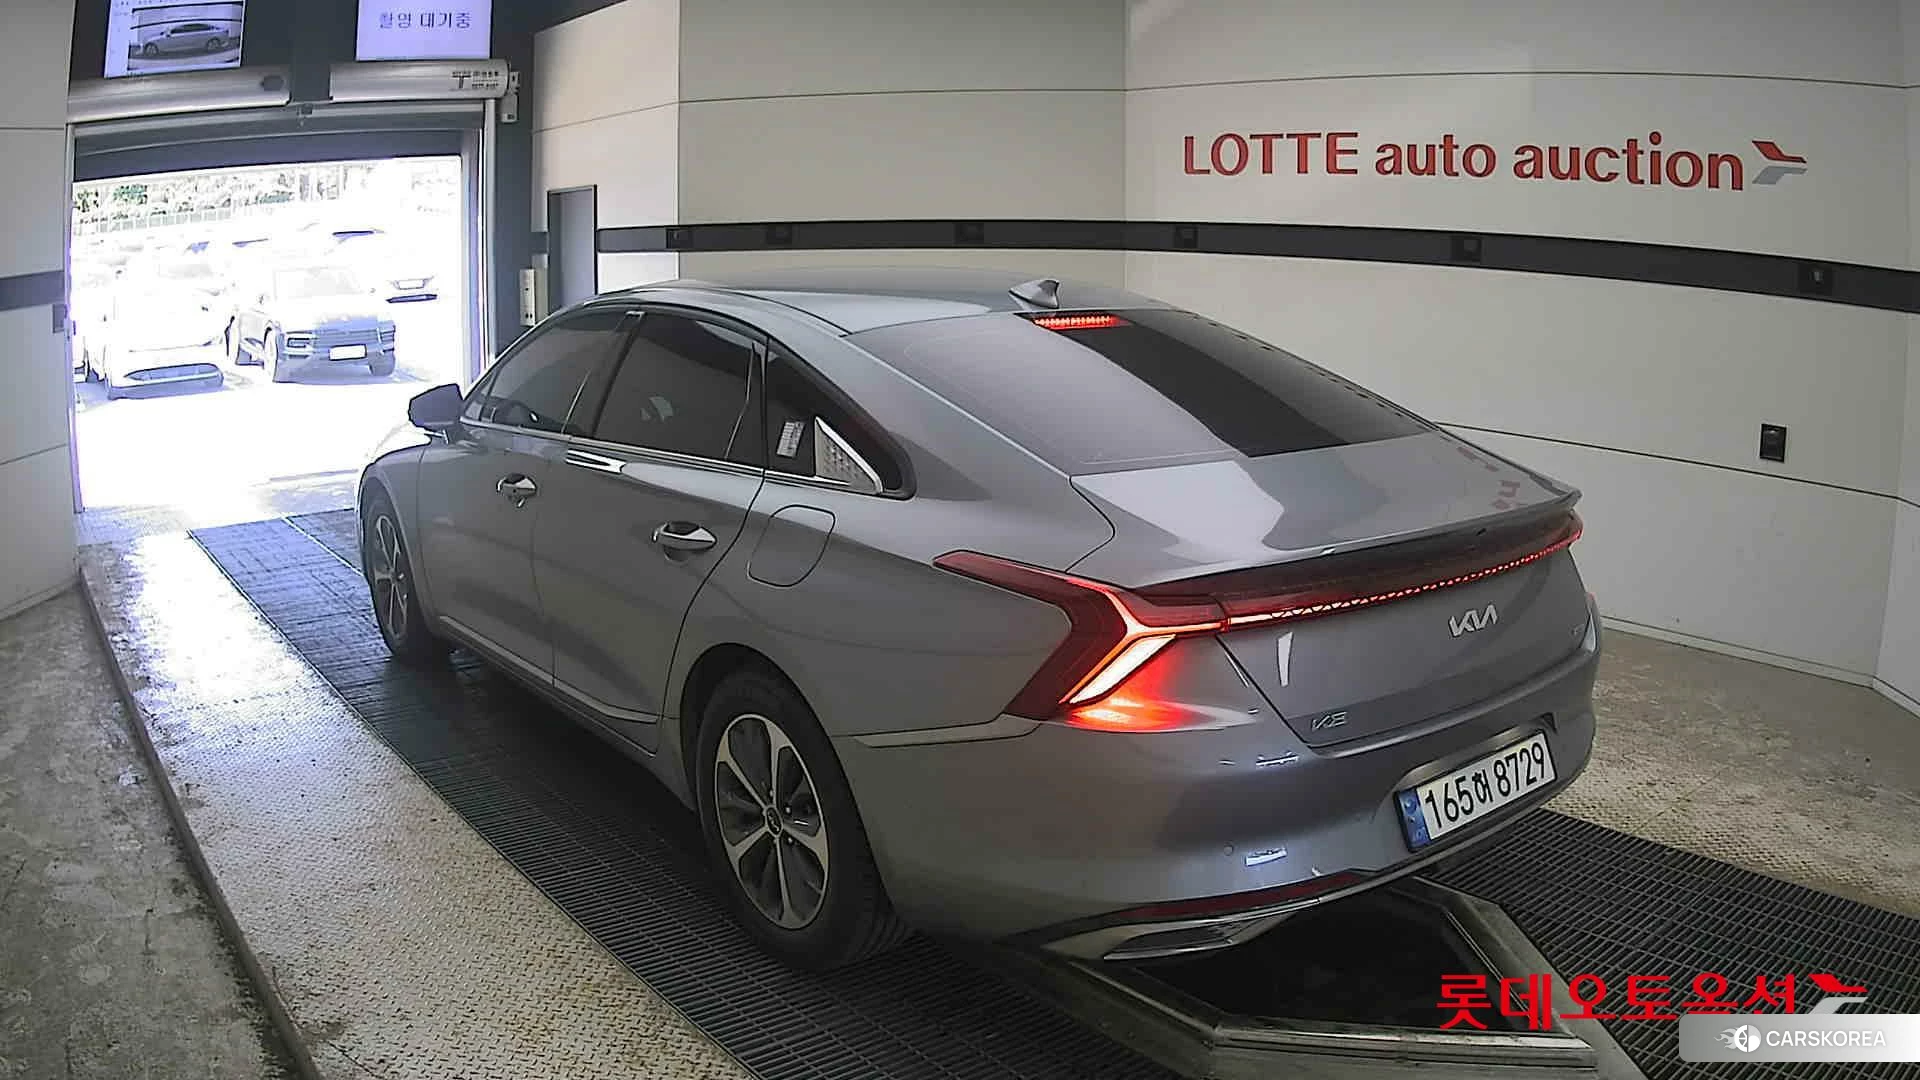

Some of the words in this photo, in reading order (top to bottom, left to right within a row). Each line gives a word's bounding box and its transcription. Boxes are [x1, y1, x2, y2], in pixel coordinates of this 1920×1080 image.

[420, 12, 473, 29] 대기중
[1184, 132, 1359, 176] LOTTE
[1375, 133, 1497, 178] auto
[1513, 131, 1744, 191] auction
[1449, 603, 1498, 637] KIA
[1424, 769, 1494, 829] 165허
[1493, 742, 1546, 797] 8729
